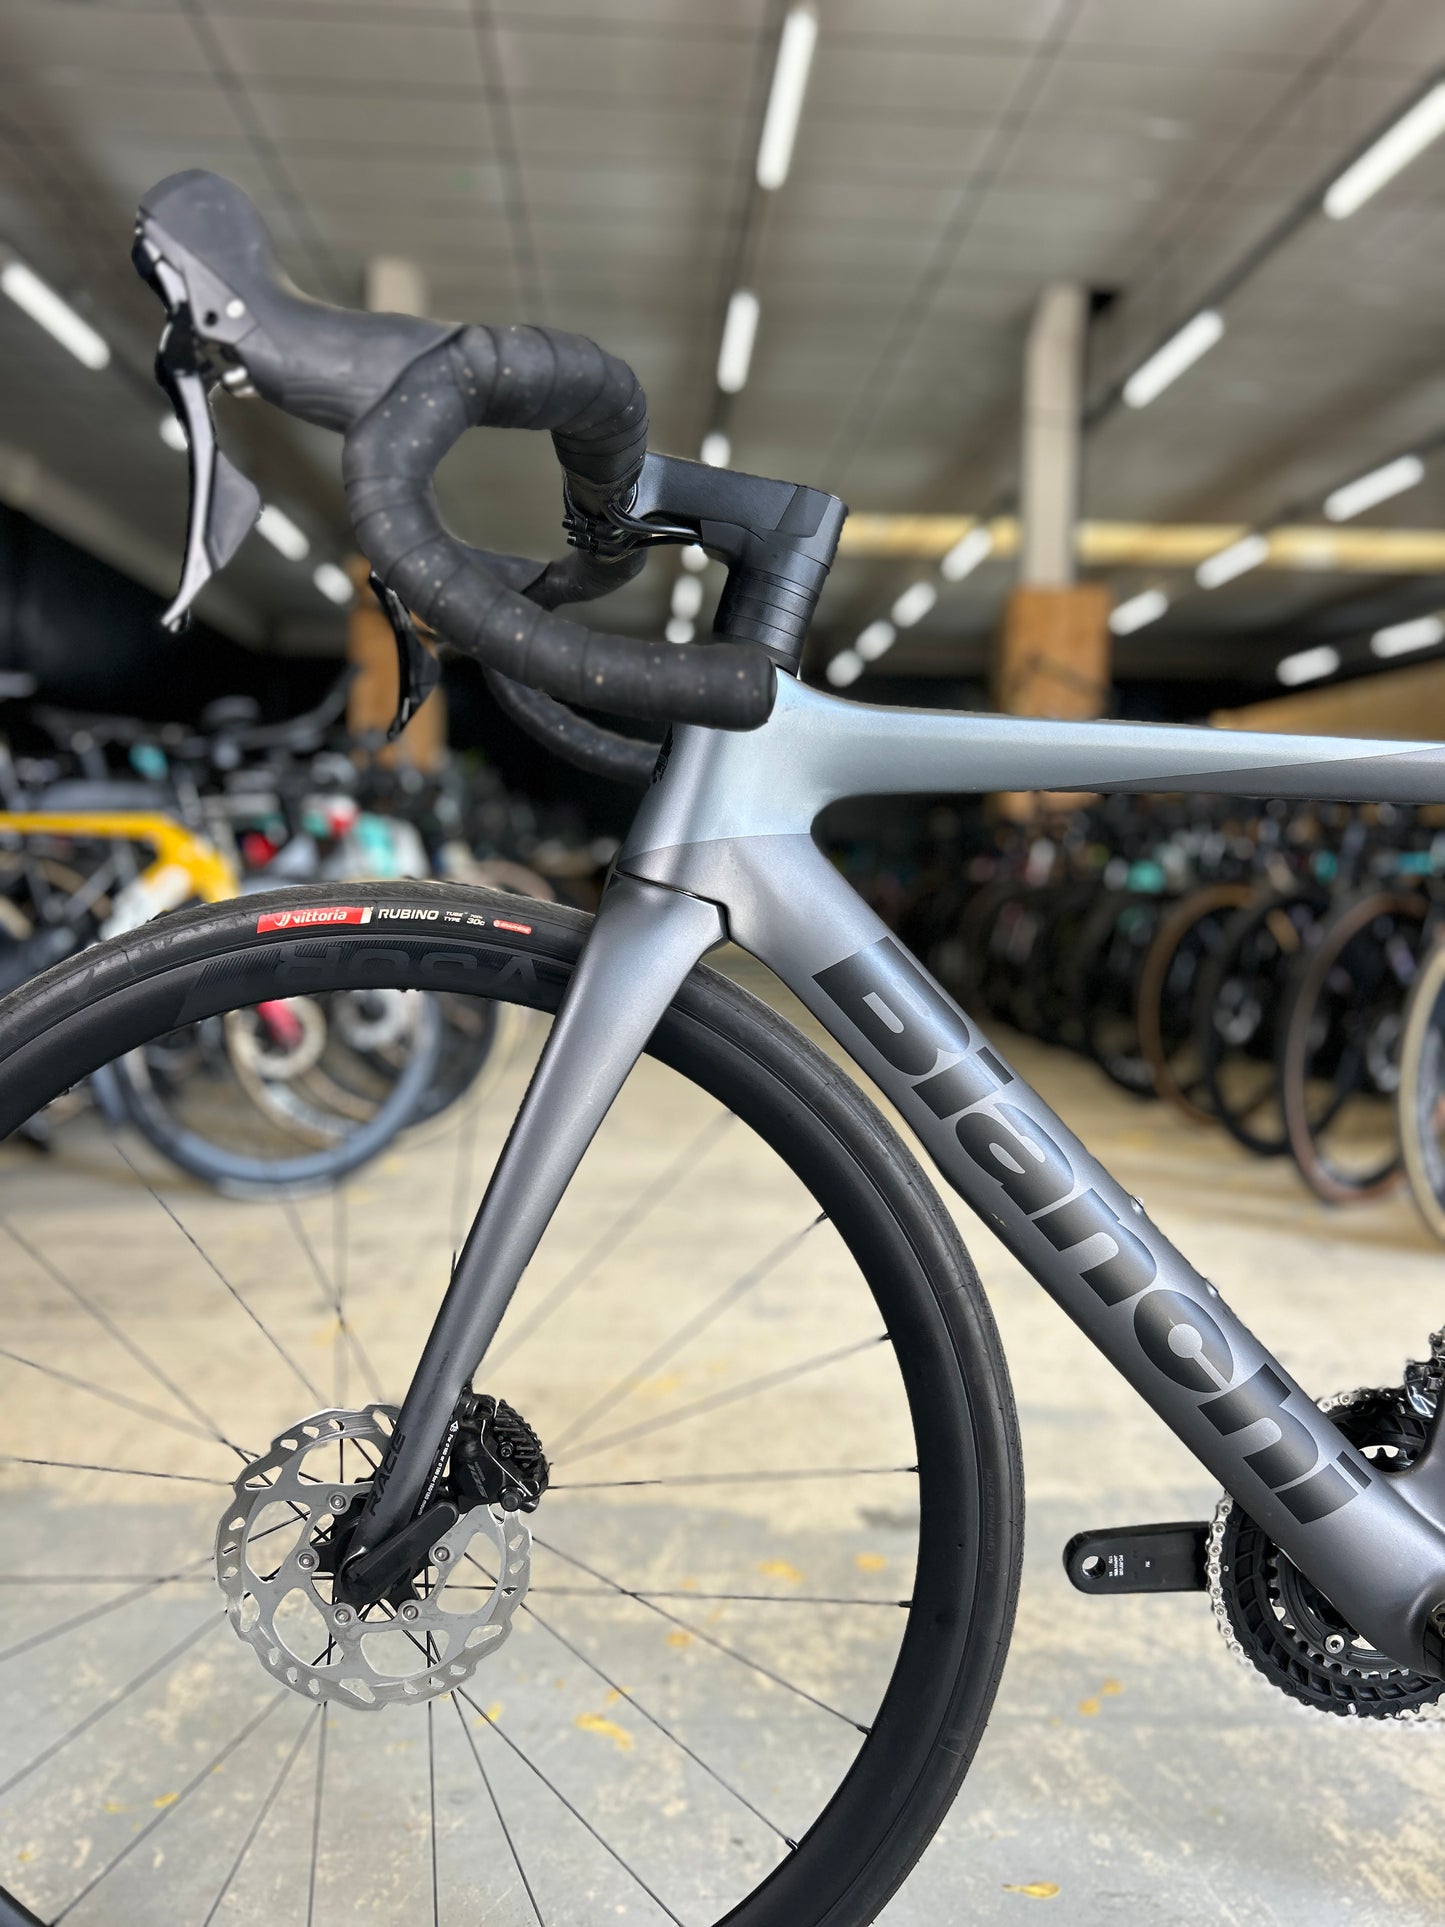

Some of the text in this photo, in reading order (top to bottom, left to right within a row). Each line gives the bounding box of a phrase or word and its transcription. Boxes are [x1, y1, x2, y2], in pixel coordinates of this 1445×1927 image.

[292, 908, 440, 924] vittoria RUBINO
[811, 935, 1372, 1524] Bianchi
[367, 1428, 406, 1516] RACE
